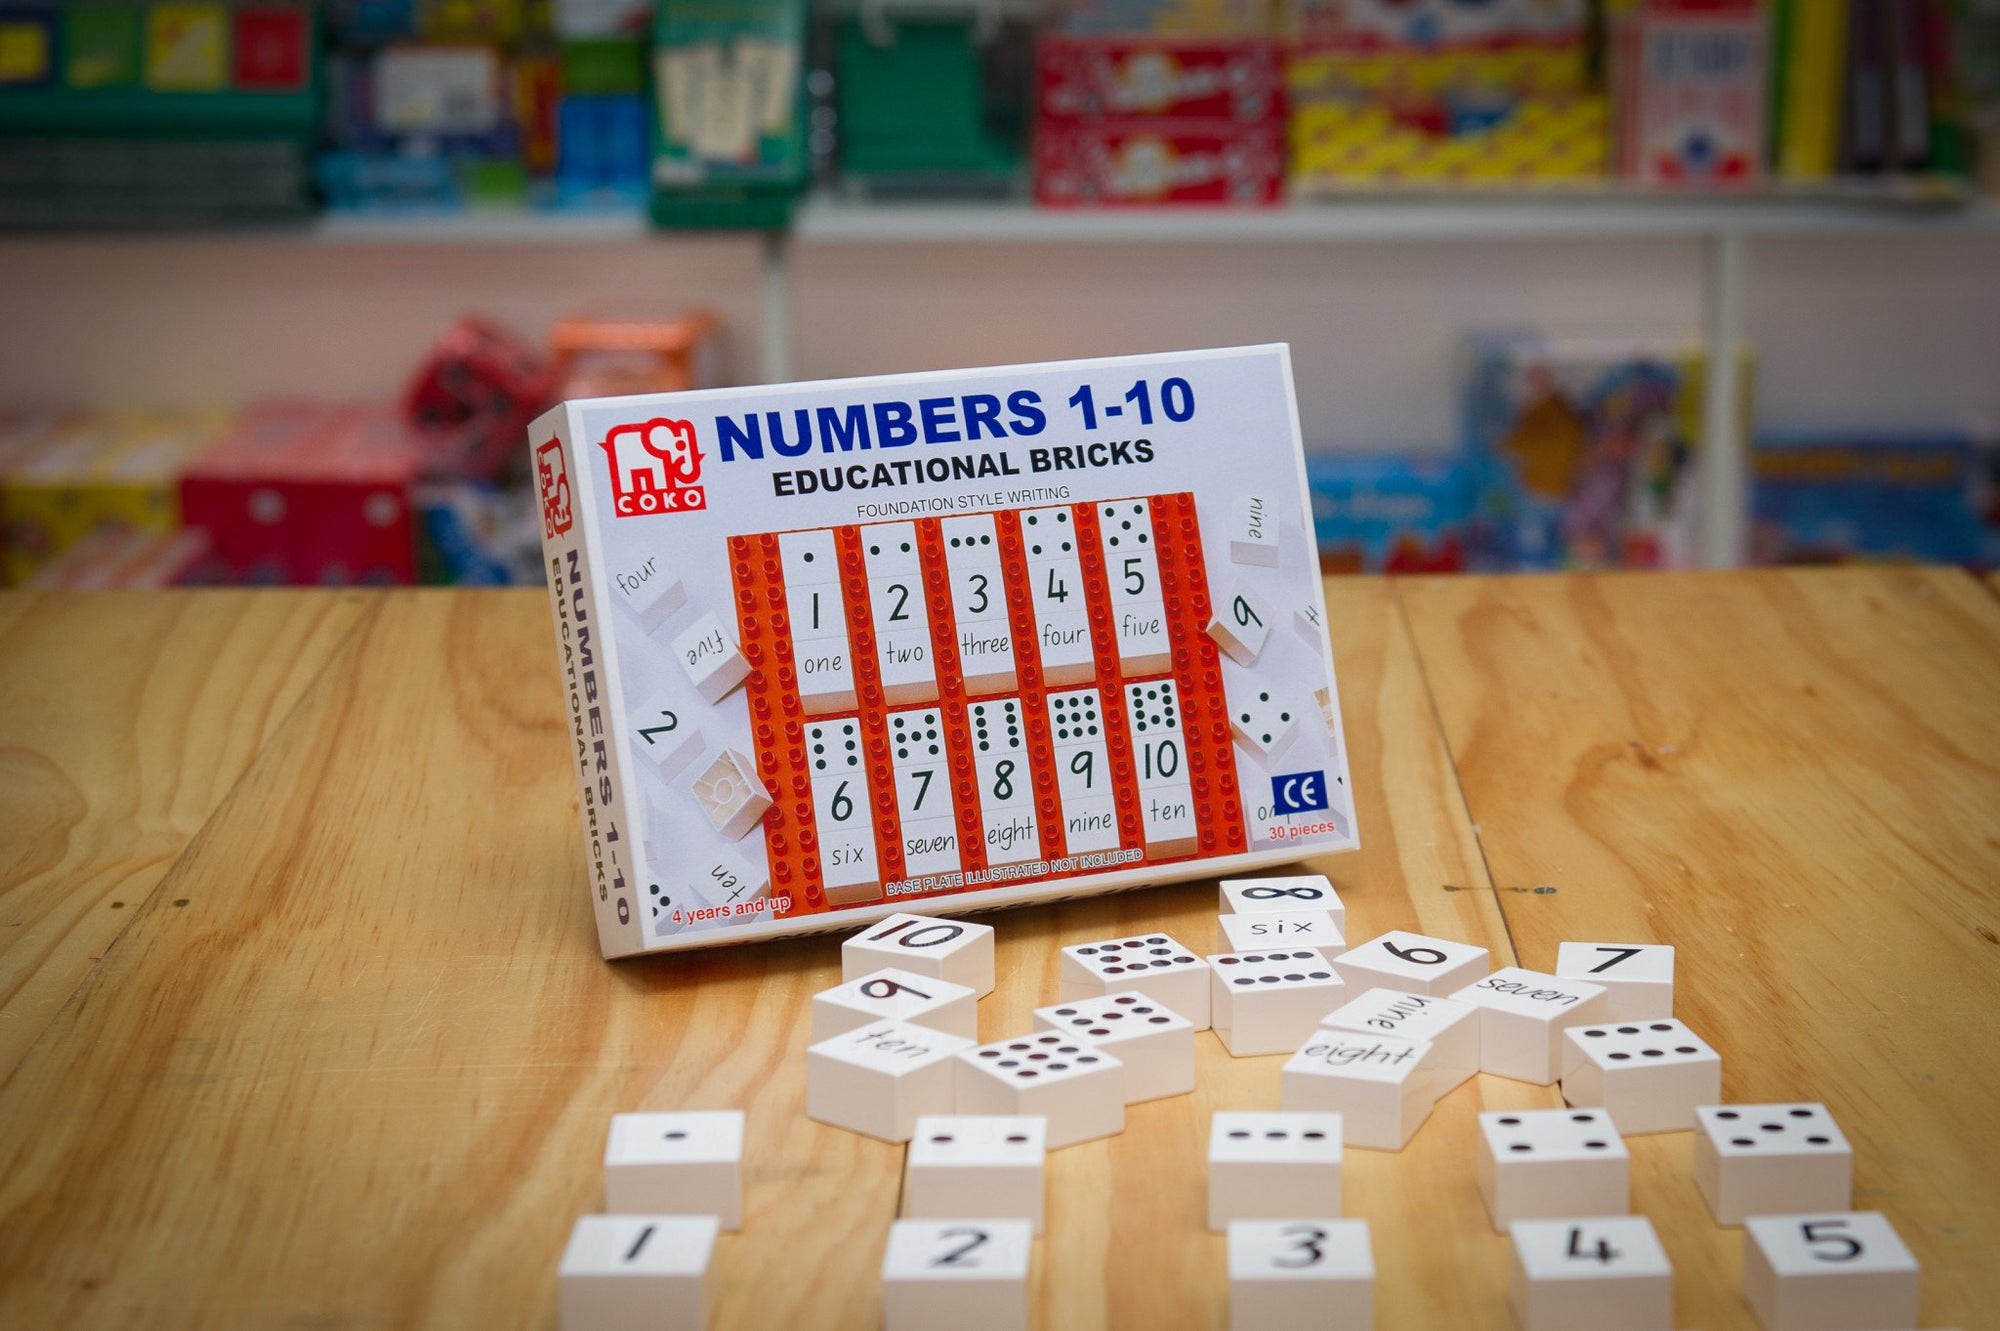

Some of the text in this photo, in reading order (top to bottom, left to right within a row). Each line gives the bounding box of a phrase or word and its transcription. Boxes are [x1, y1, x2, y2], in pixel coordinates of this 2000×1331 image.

[715, 376, 1196, 463] NUMBERS 1-10
[772, 438, 1155, 497] EDUCATIONAL BRICKS
[537, 451, 555, 534] COKO
[617, 487, 702, 514] COKO
[857, 486, 1071, 519] FOUNDATION STYLE WRITING
[1248, 496, 1264, 540] nine
[616, 556, 656, 596] four
[968, 574, 989, 614] 3
[1047, 568, 1069, 604] 4
[1124, 558, 1145, 596] 5
[813, 592, 820, 630] 1
[886, 583, 910, 622] 2
[960, 631, 1009, 658] three
[1042, 623, 1086, 648] four
[1122, 615, 1161, 639] five
[686, 629, 724, 665] five
[804, 655, 843, 674] one
[885, 640, 924, 665] two
[552, 557, 608, 902] EDUCATIONAL BRICKS
[566, 549, 630, 926] NUMBERS 1-10
[637, 710, 678, 745] 2
[1070, 750, 1094, 789] 9
[1144, 739, 1179, 780] 10
[910, 770, 934, 811] 7
[993, 759, 1016, 801] 8
[1283, 776, 1318, 809] CE
[830, 780, 854, 822] 6
[1149, 798, 1186, 823] ten
[987, 815, 1034, 852] eight
[1069, 809, 1112, 834] nine
[1269, 821, 1336, 841] 30 pieces
[832, 844, 864, 866] six
[906, 833, 955, 856] seven
[710, 863, 747, 903] ten
[886, 848, 1144, 897] BASE PLATE ILLUSTRATED NOT INCLUDED
[672, 895, 791, 927] 4 years and up
[1250, 918, 1314, 936] six
[867, 919, 964, 948] 10
[1587, 946, 1644, 974] 7
[1475, 975, 1581, 1007] seven
[1367, 994, 1432, 1031] nine
[854, 1027, 931, 1059] ten
[1303, 1042, 1417, 1066] eight
[926, 1226, 992, 1269] 2
[1271, 1224, 1329, 1270] 3
[1564, 1225, 1623, 1267] 4
[1800, 1220, 1867, 1264] 5
